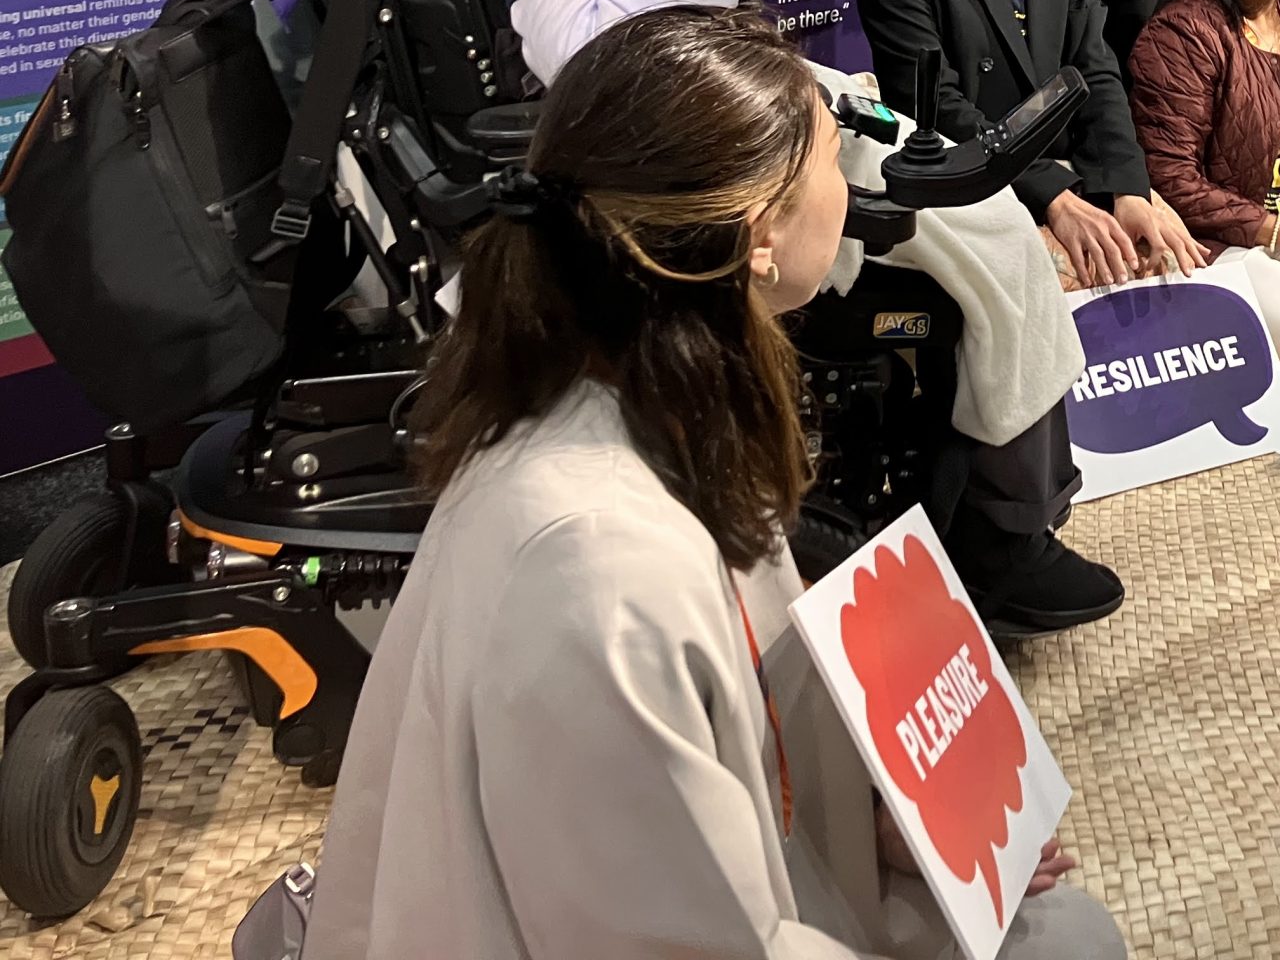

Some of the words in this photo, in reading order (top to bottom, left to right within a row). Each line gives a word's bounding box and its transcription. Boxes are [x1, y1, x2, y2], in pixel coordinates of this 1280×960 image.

[23, 1, 86, 19] universal
[876, 315, 904, 329] JAY
[1072, 336, 1246, 402] RESILIENCE
[896, 643, 988, 781] PLEASURE
